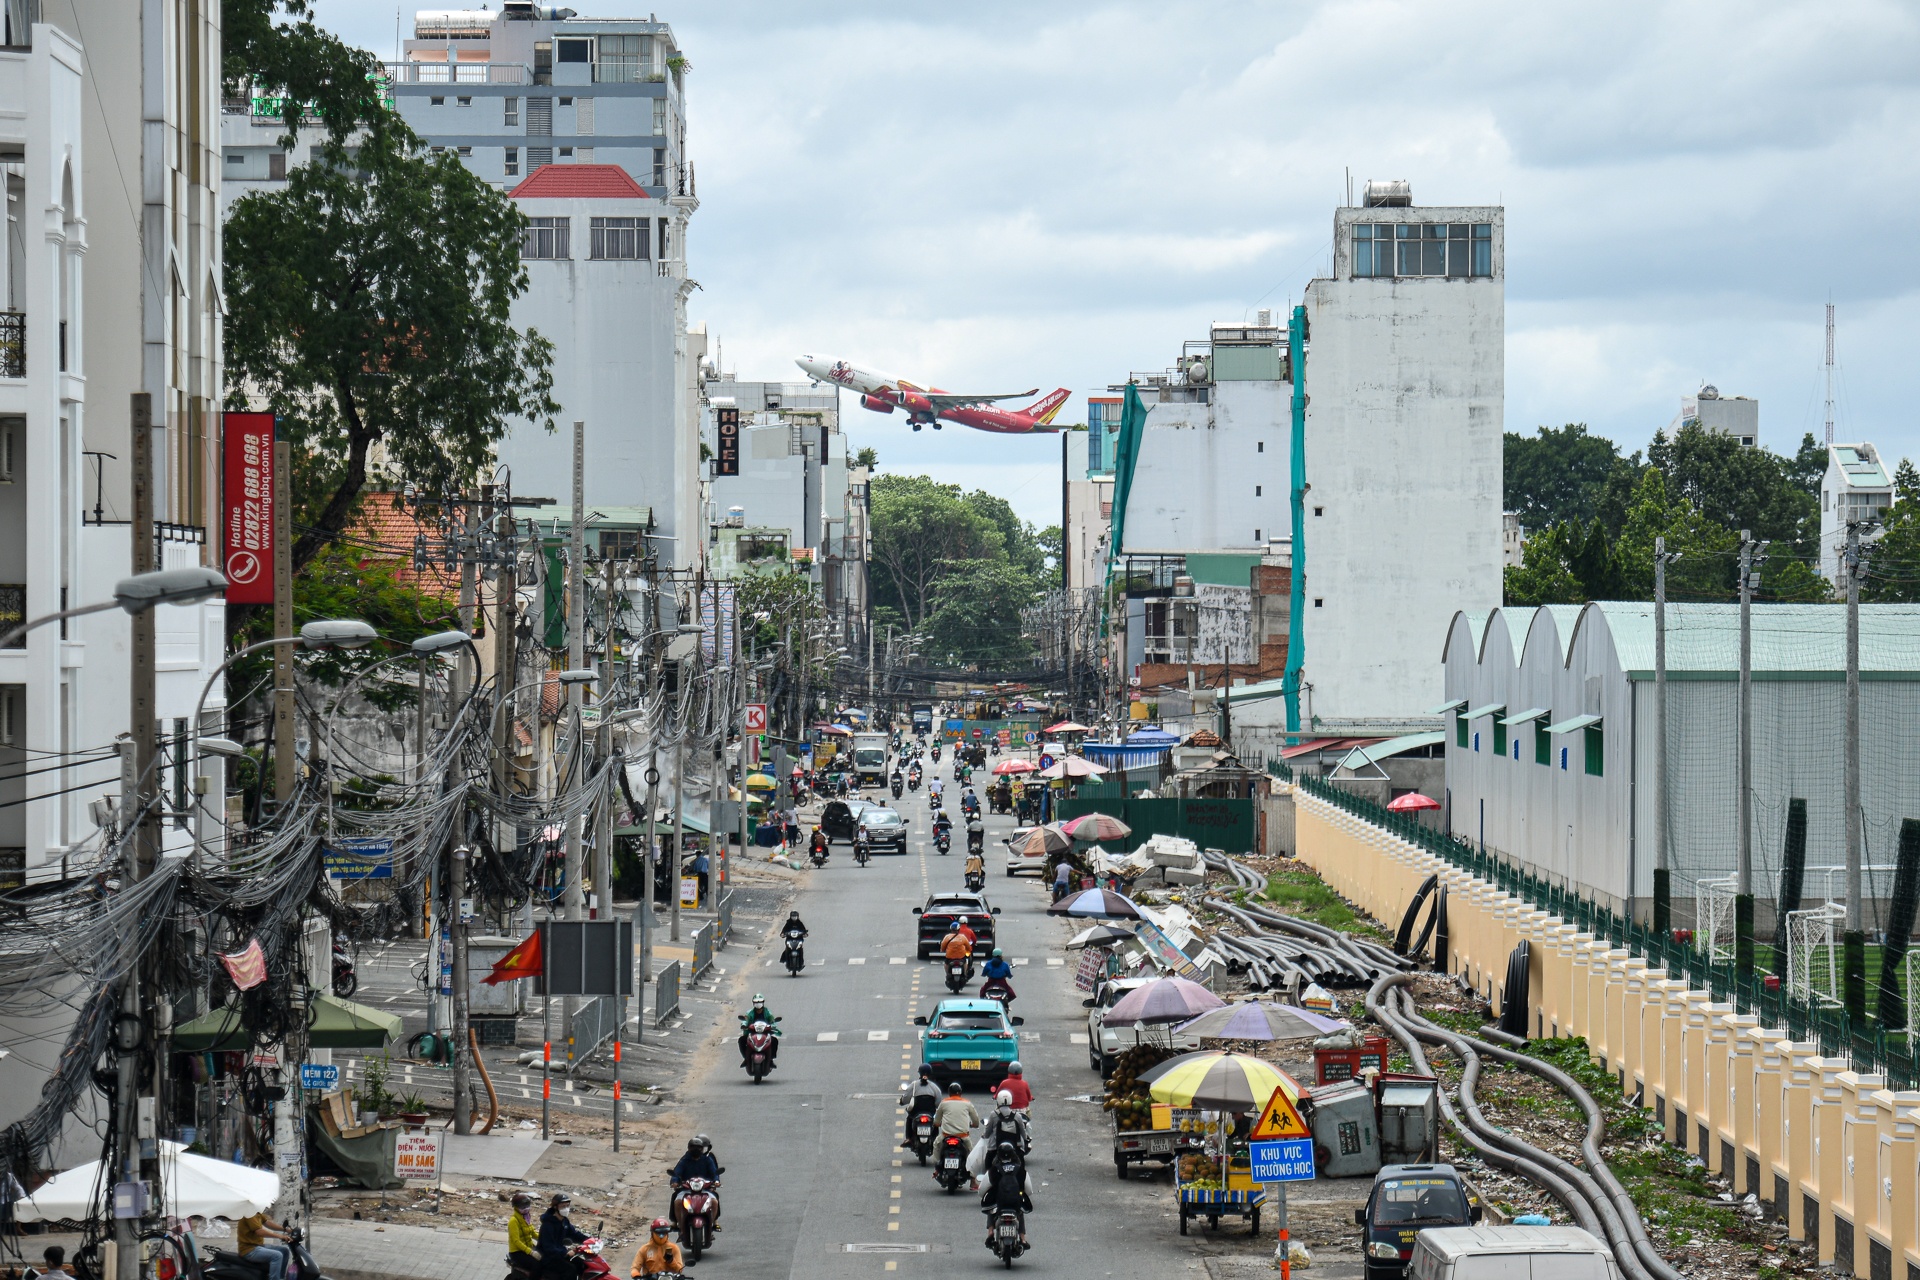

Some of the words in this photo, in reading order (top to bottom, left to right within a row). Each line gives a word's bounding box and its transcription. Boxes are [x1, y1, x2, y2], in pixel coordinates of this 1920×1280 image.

[244, 433, 259, 466] 688
[721, 411, 736, 473] HOTEL
[244, 467, 259, 499] 688
[260, 433, 272, 550] www.kingbbq.com.vn
[231, 507, 241, 548] Hotline
[244, 500, 259, 550] 02822
[323, 1067, 337, 1079] 127
[398, 1143, 413, 1152] ĐIỆN
[418, 1143, 436, 1152] NƯỚC
[398, 1151, 414, 1167] ÁNH
[415, 1152, 435, 1167] SÁNG
[1261, 1147, 1280, 1161] KHU
[1283, 1146, 1303, 1161] VỰC
[1254, 1161, 1292, 1177] TRƯỜNG
[1293, 1161, 1312, 1176] HỌC
[1398, 1230, 1414, 1238] NHẬN
